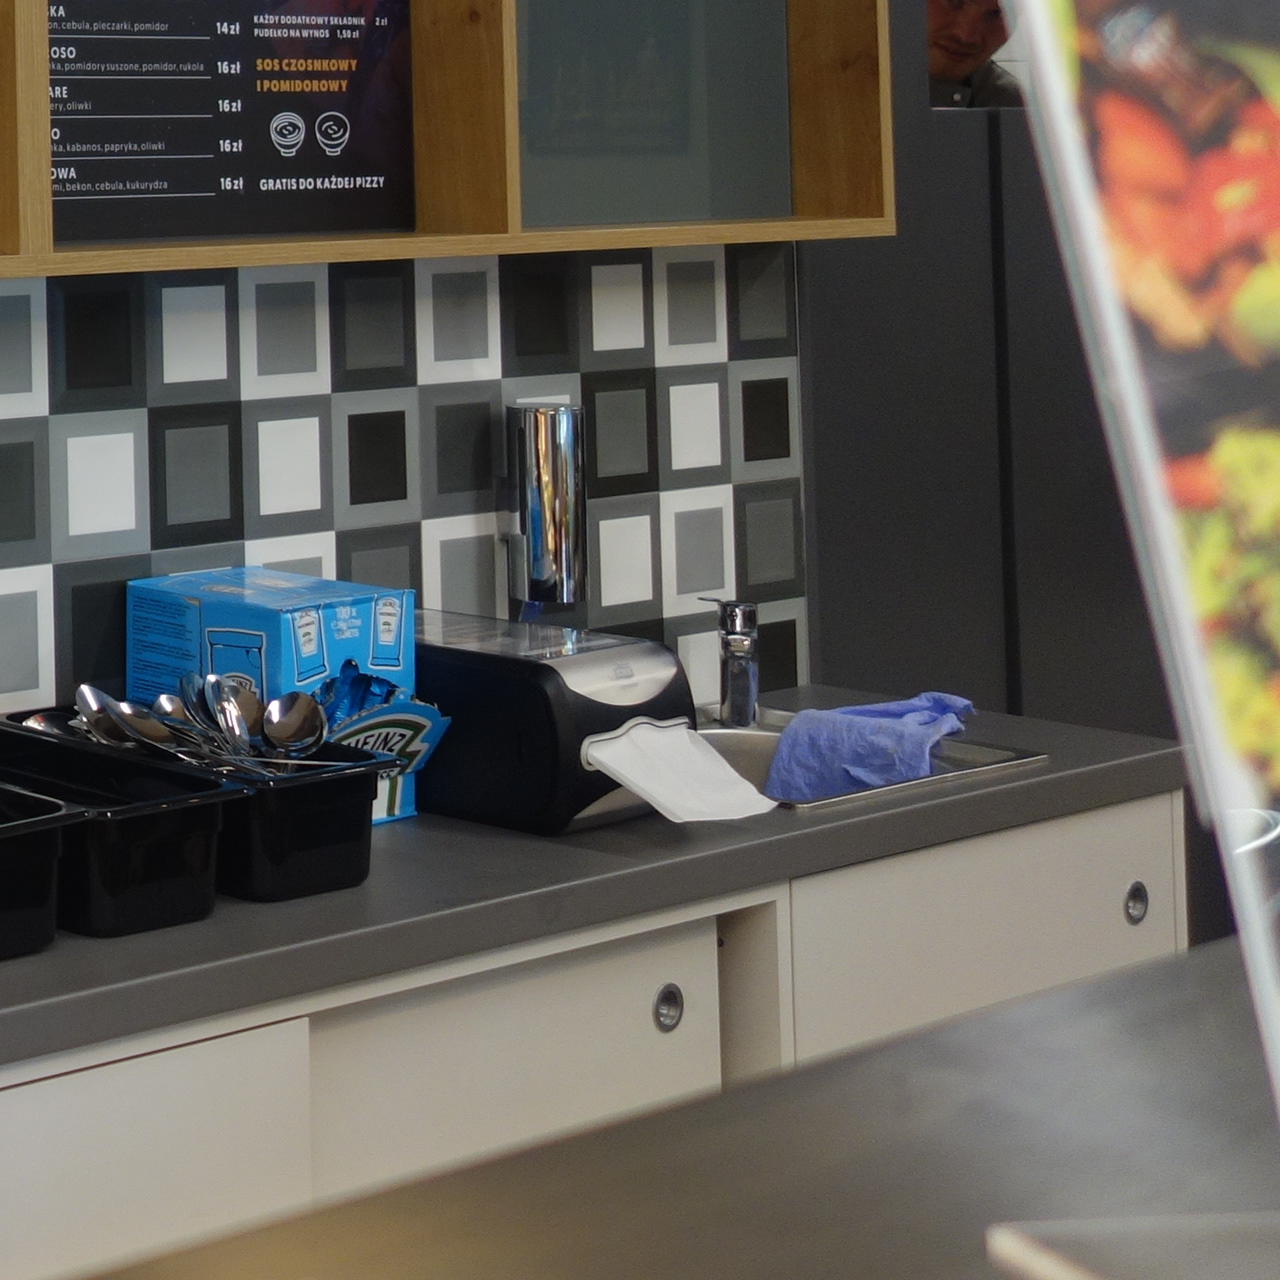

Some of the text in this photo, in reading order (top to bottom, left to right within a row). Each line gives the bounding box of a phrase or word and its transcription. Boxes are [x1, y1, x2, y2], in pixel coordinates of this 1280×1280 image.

[253, 13, 279, 24] KAŻDY
[280, 15, 328, 25] DODATKOWY
[134, 21, 169, 31] pomidor
[254, 28, 288, 38] PUDEŁKO
[290, 29, 300, 38] NA
[301, 29, 329, 38] WYNOS
[48, 46, 76, 59] OSO
[65, 61, 105, 72] pomidory
[179, 62, 204, 71] rukola
[256, 58, 358, 71] SOS CZOSNKOWY
[256, 79, 348, 92] I POMIDOROWY
[66, 101, 92, 110] oliwki
[140, 141, 165, 150] oliwki
[126, 180, 168, 191] kukurydza
[260, 175, 384, 191] GRATIS DO KAŻDEJ PIZZY
